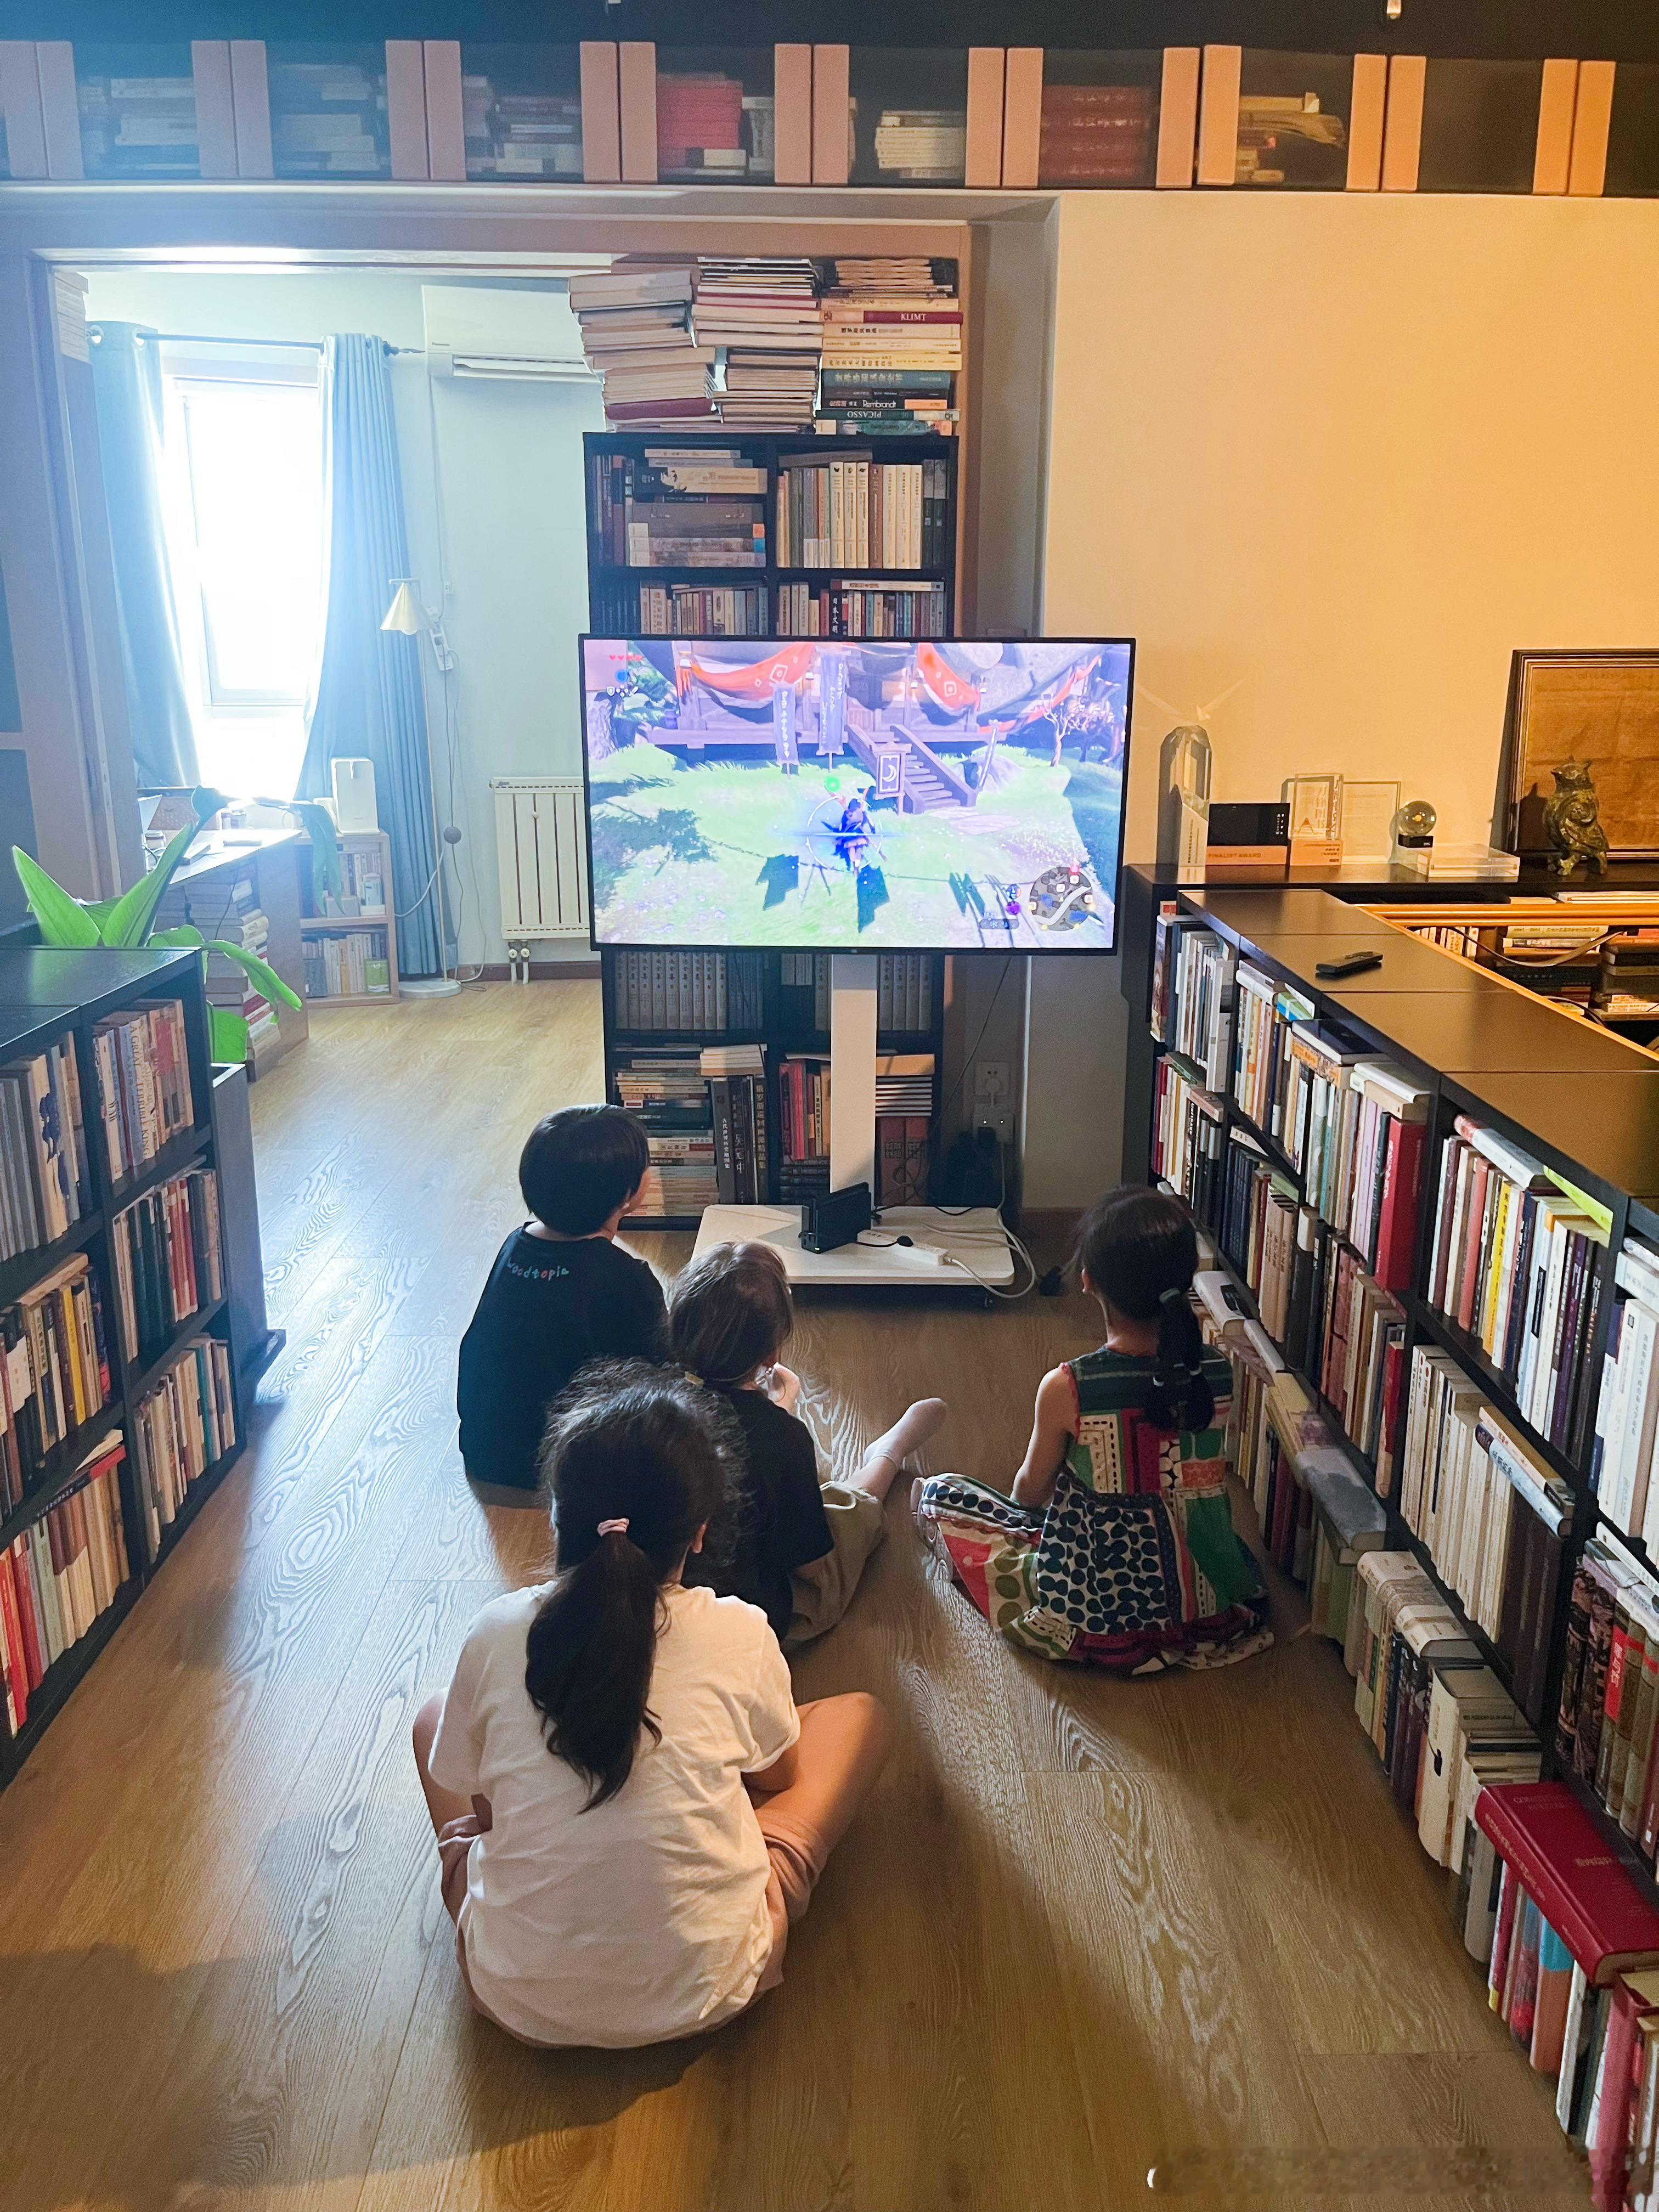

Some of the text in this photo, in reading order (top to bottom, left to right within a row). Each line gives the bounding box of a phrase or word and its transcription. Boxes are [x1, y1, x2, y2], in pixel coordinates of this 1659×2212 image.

[901, 313, 927, 321] KLIMT
[862, 399, 896, 409] Rembrandt
[136, 1082, 147, 1128] TERRIBLE
[140, 1130, 150, 1155] KING
[735, 1133, 745, 1175] 吴冠中
